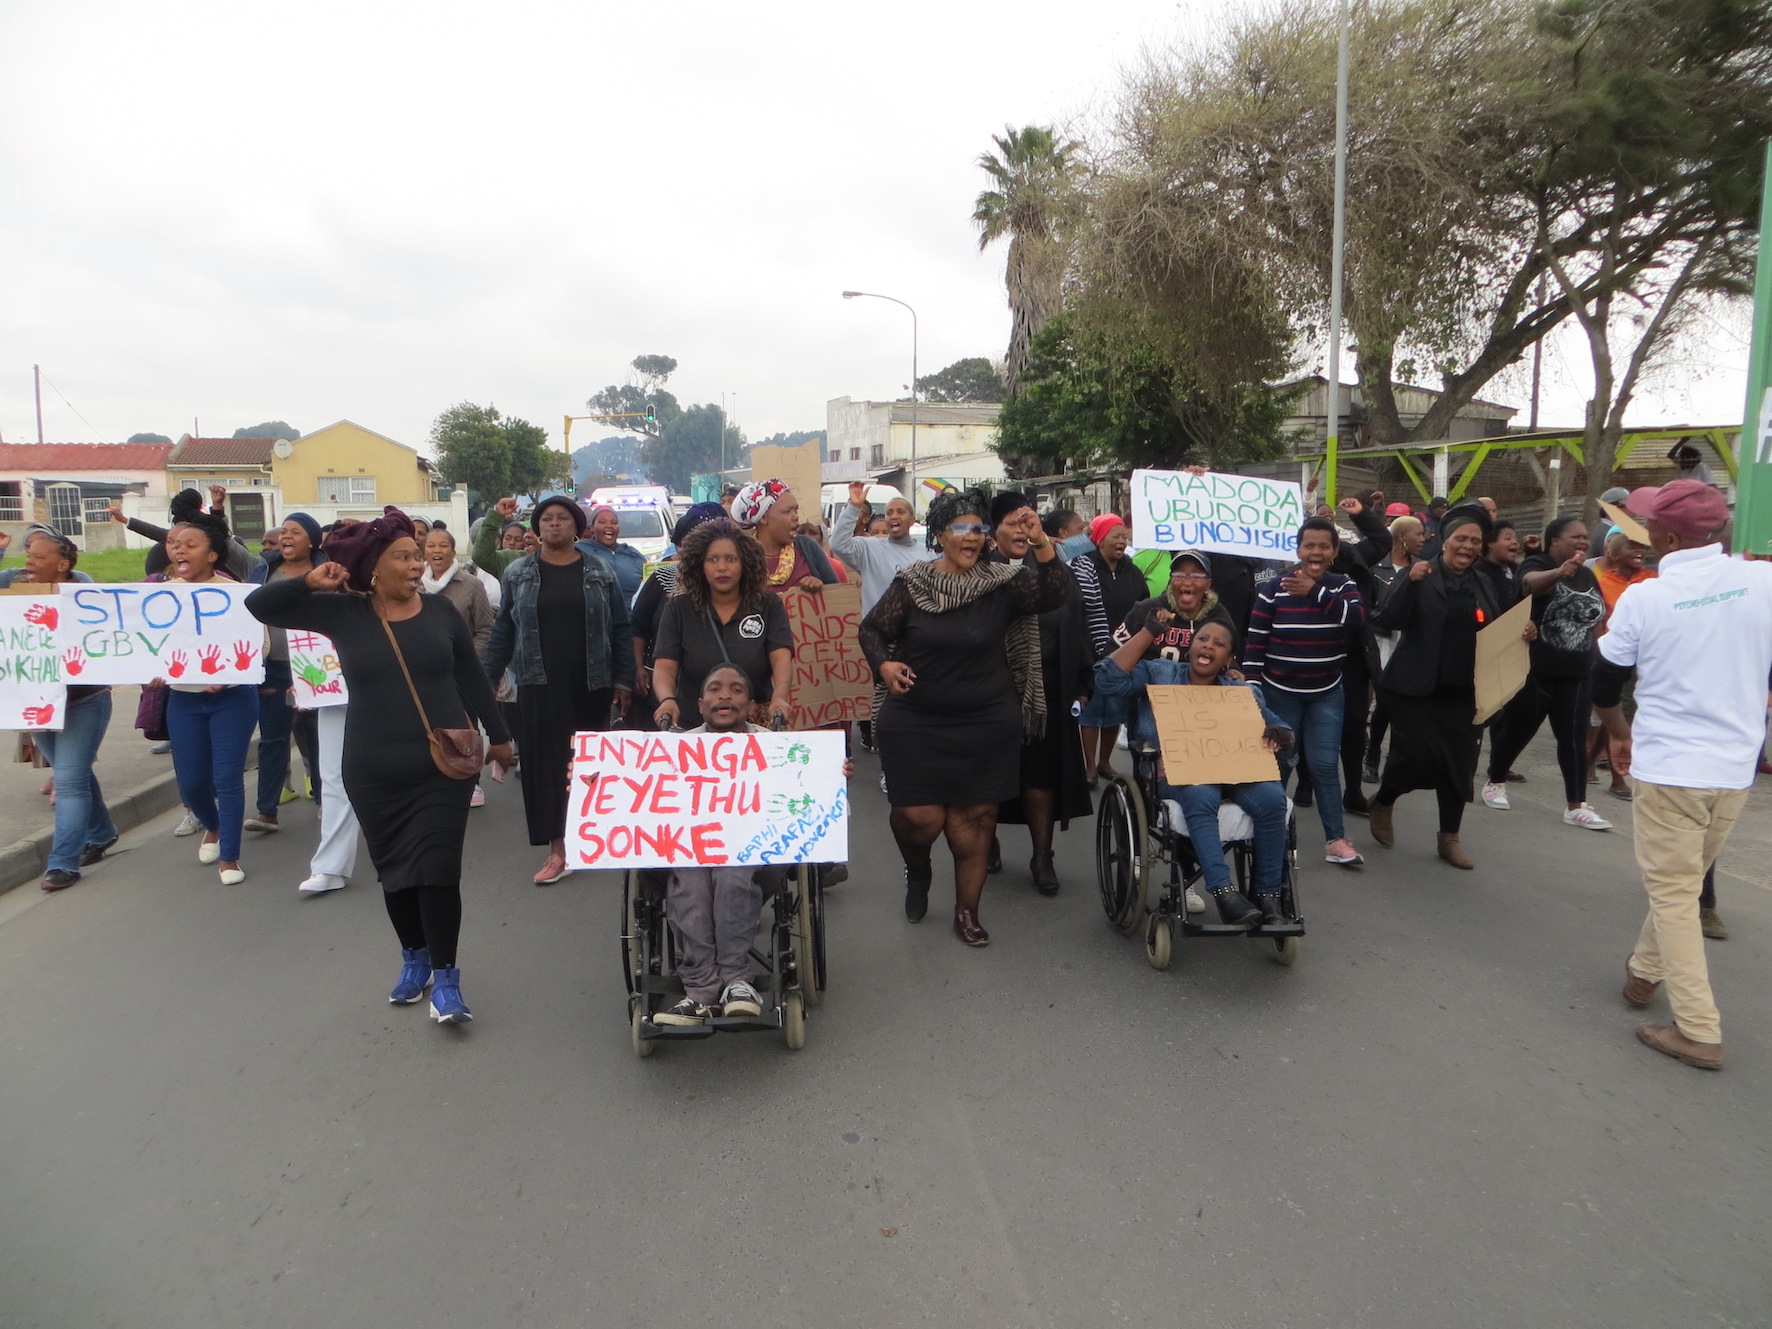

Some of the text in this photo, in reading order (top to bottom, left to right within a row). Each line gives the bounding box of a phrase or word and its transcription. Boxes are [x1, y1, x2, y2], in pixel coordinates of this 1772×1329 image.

[1144, 475, 1299, 514] MADODA
[1149, 499, 1299, 530] UBUDODA
[74, 587, 232, 636] STOP
[82, 630, 171, 657] GBV
[824, 658, 872, 685] KIDS
[1166, 711, 1218, 733] IS
[575, 733, 768, 779] INYANGA
[1163, 737, 1267, 763] ENOUG
[579, 772, 761, 817] YEYETHU
[577, 821, 729, 865] SONKE
